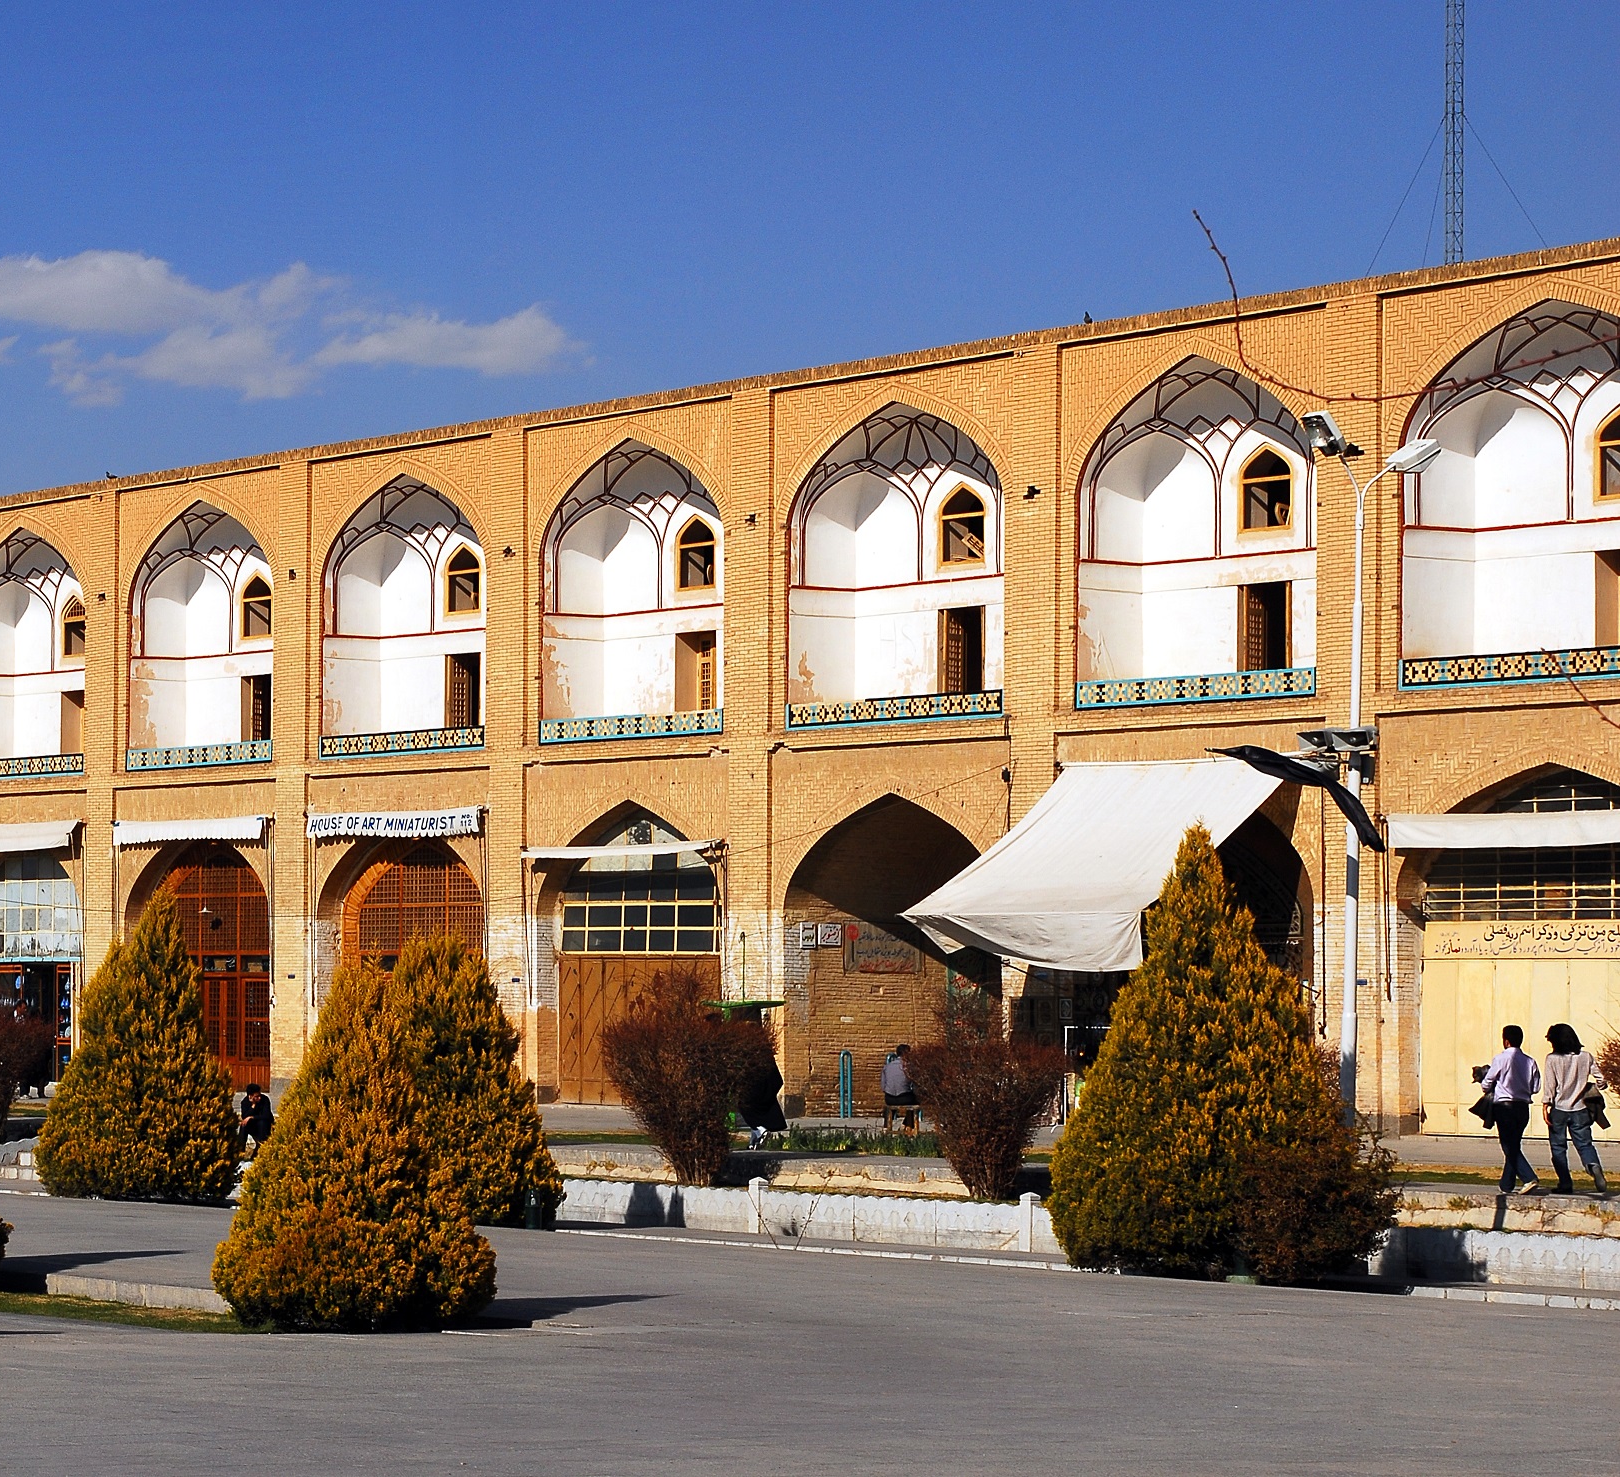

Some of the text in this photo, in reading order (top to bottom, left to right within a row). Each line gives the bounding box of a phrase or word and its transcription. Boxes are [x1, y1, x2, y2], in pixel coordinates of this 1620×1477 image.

[309, 815, 456, 833] HOUSE OF ART MINIATURIST
